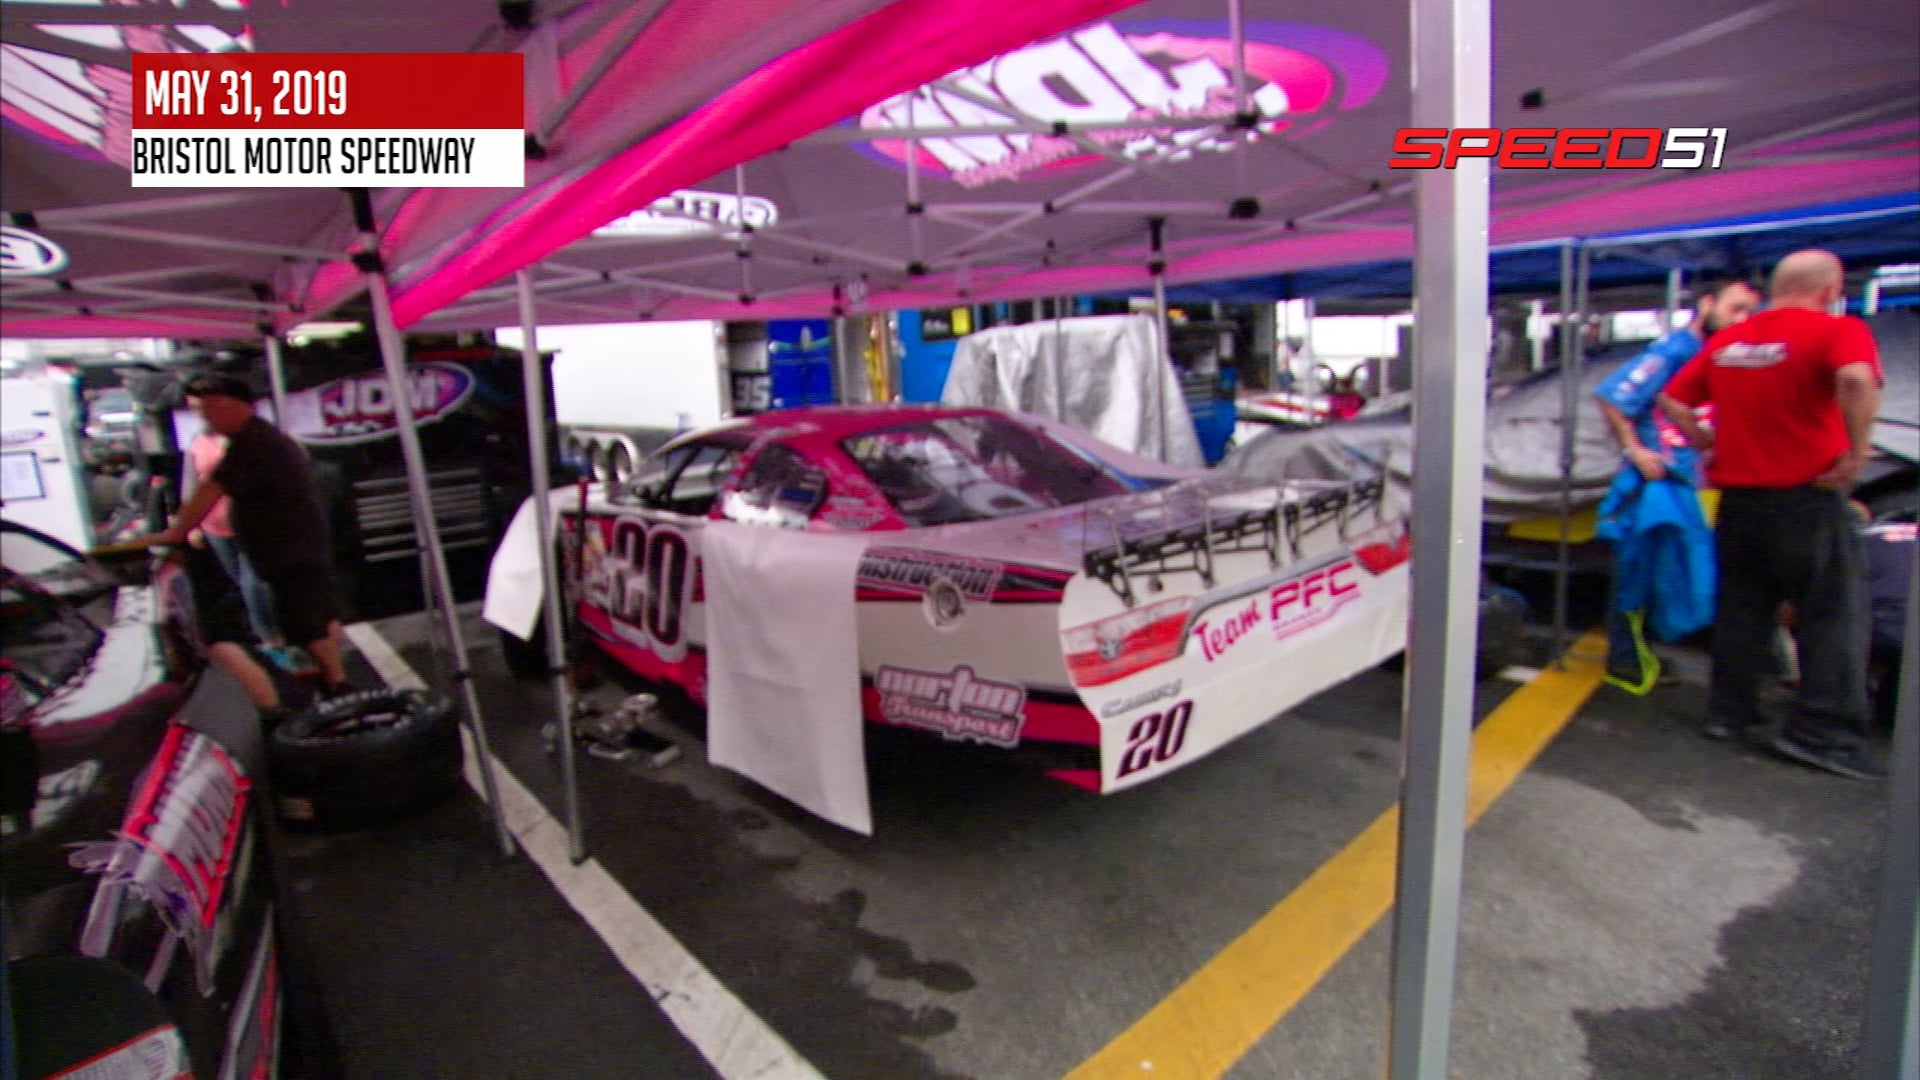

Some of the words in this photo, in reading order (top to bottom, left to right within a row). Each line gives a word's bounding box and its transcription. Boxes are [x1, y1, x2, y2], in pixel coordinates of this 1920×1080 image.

[611, 518, 689, 656] 20
[1192, 599, 1262, 662] Team
[1270, 561, 1358, 621] PFC
[1115, 698, 1194, 779] 20
